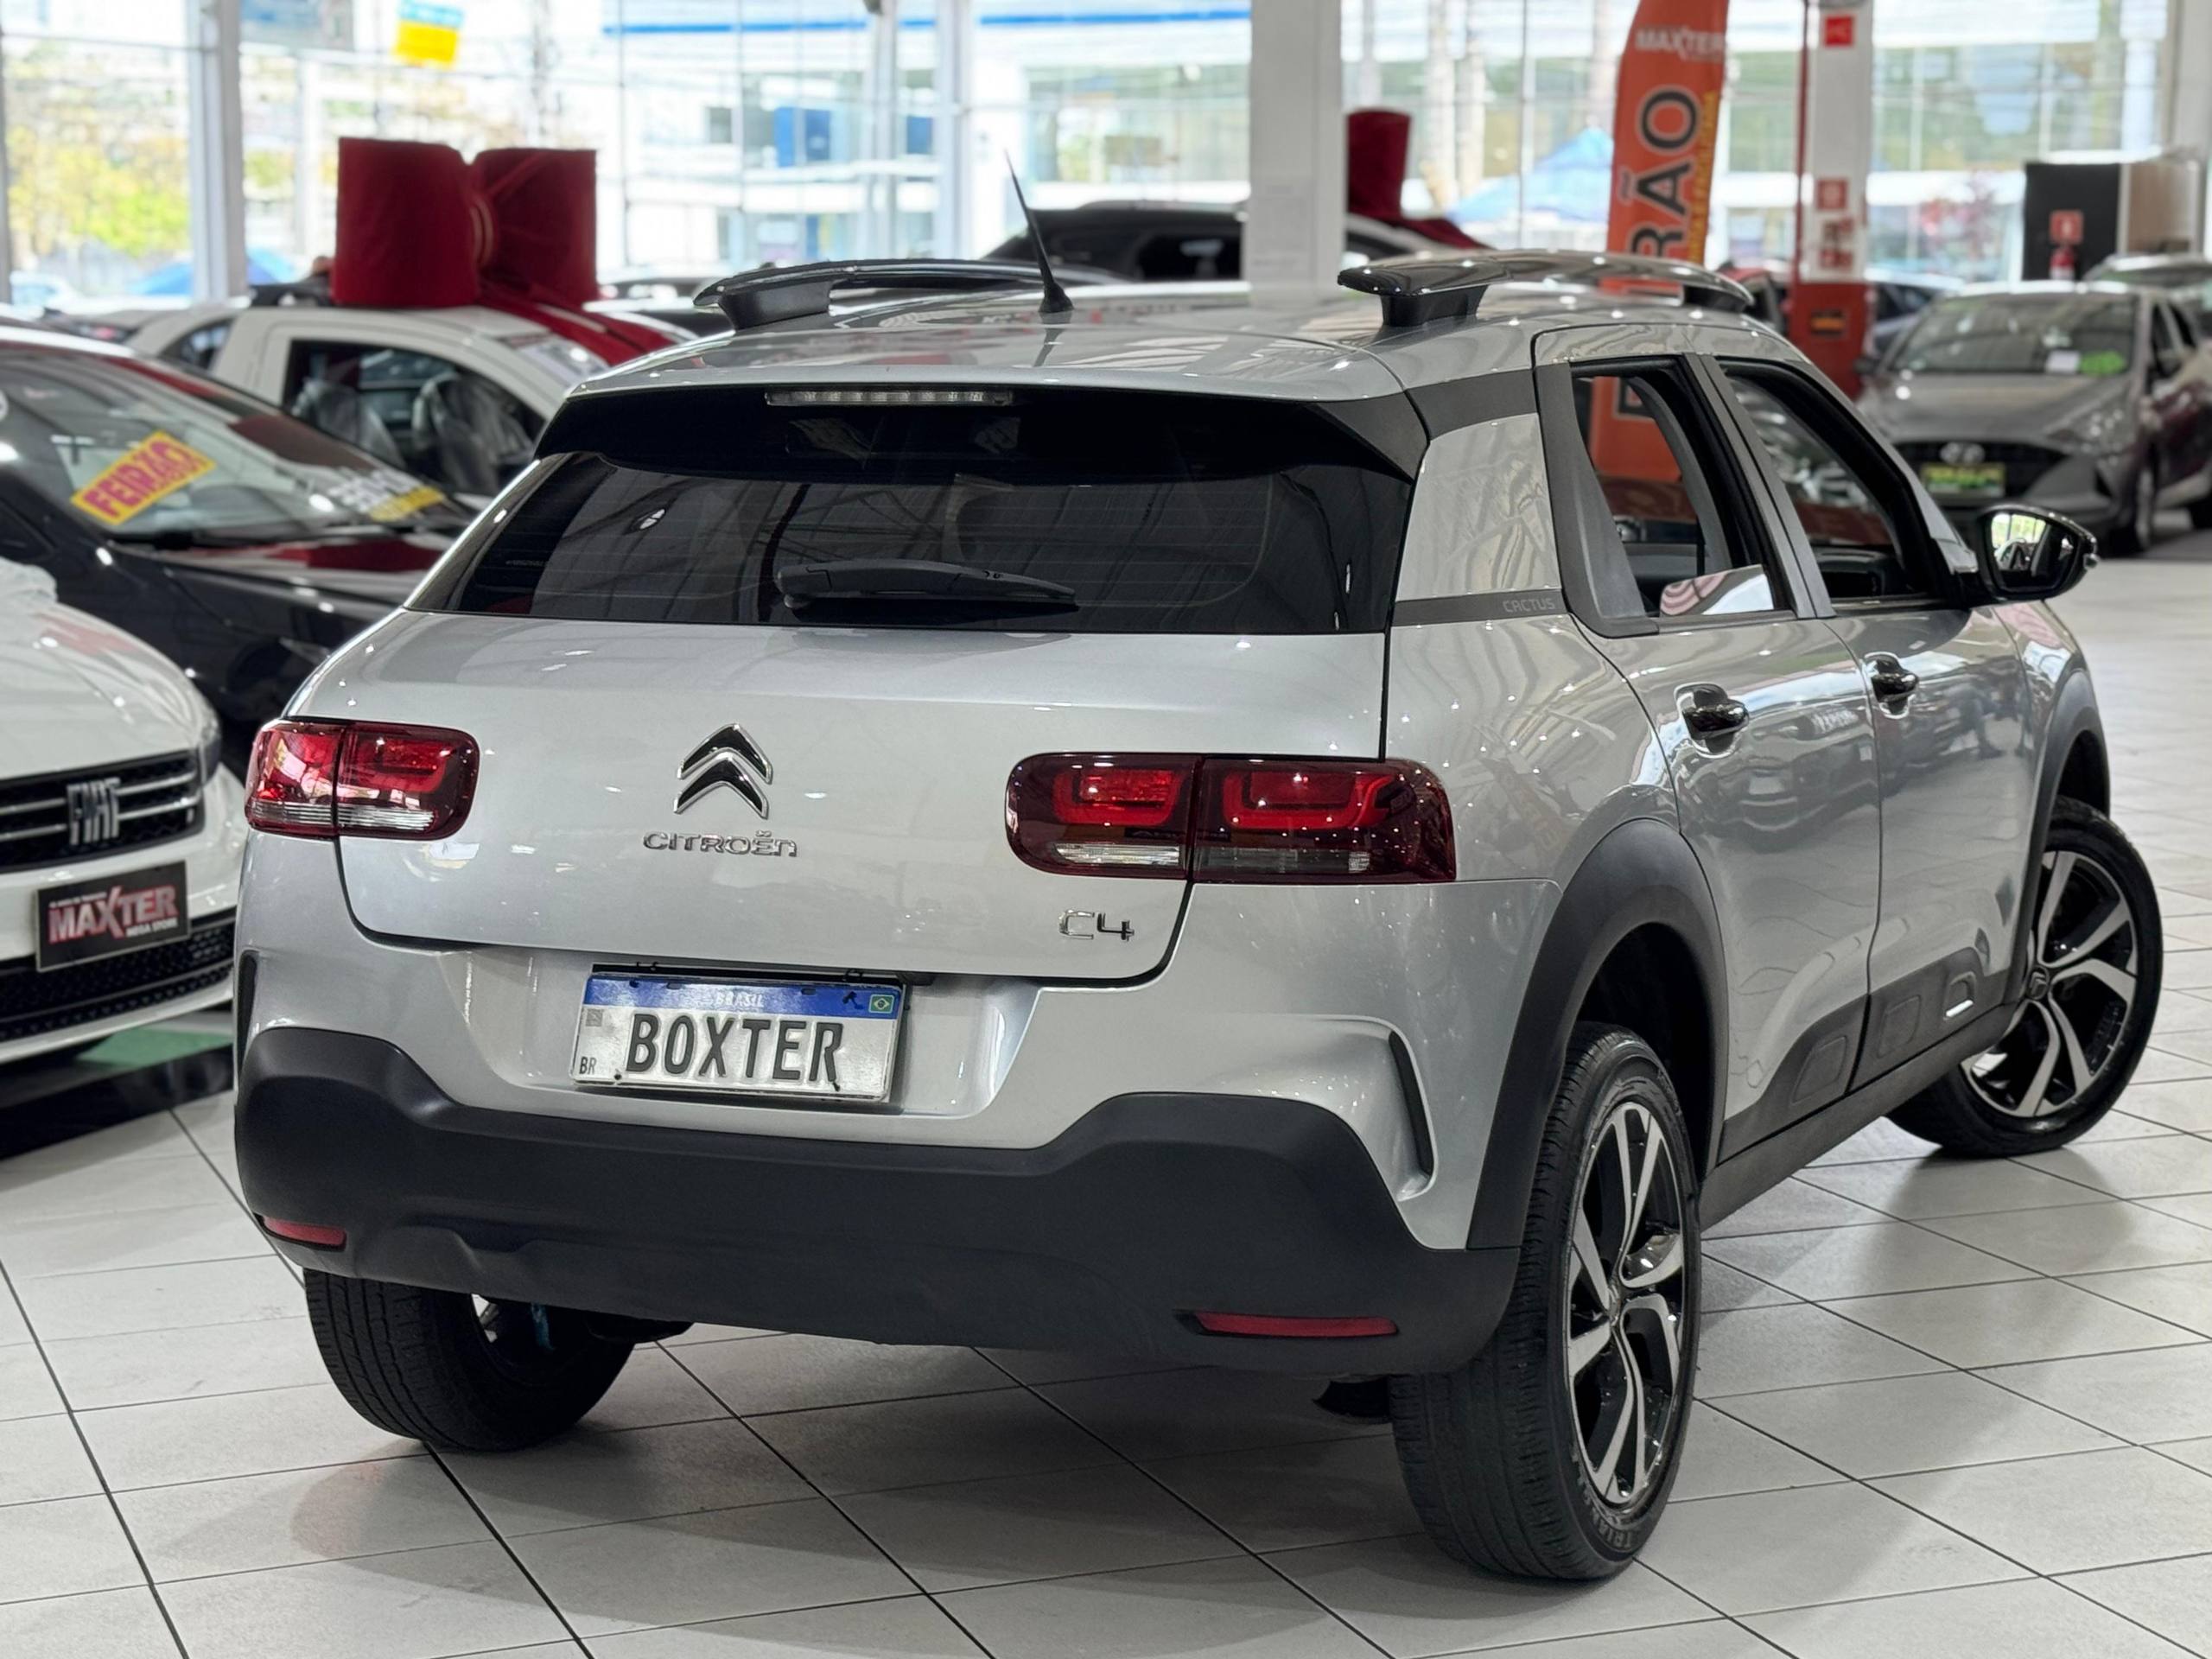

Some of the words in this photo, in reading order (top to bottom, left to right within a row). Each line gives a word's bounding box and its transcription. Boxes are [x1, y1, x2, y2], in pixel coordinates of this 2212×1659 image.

[1503, 598, 1556, 613] CACTUS
[67, 777, 120, 845] FIAT
[48, 886, 179, 944] MAXTER
[1058, 909, 1135, 942] C4
[715, 988, 765, 1008] BRASIL
[626, 1014, 843, 1083] BOXTER
[579, 1056, 596, 1075] BR
